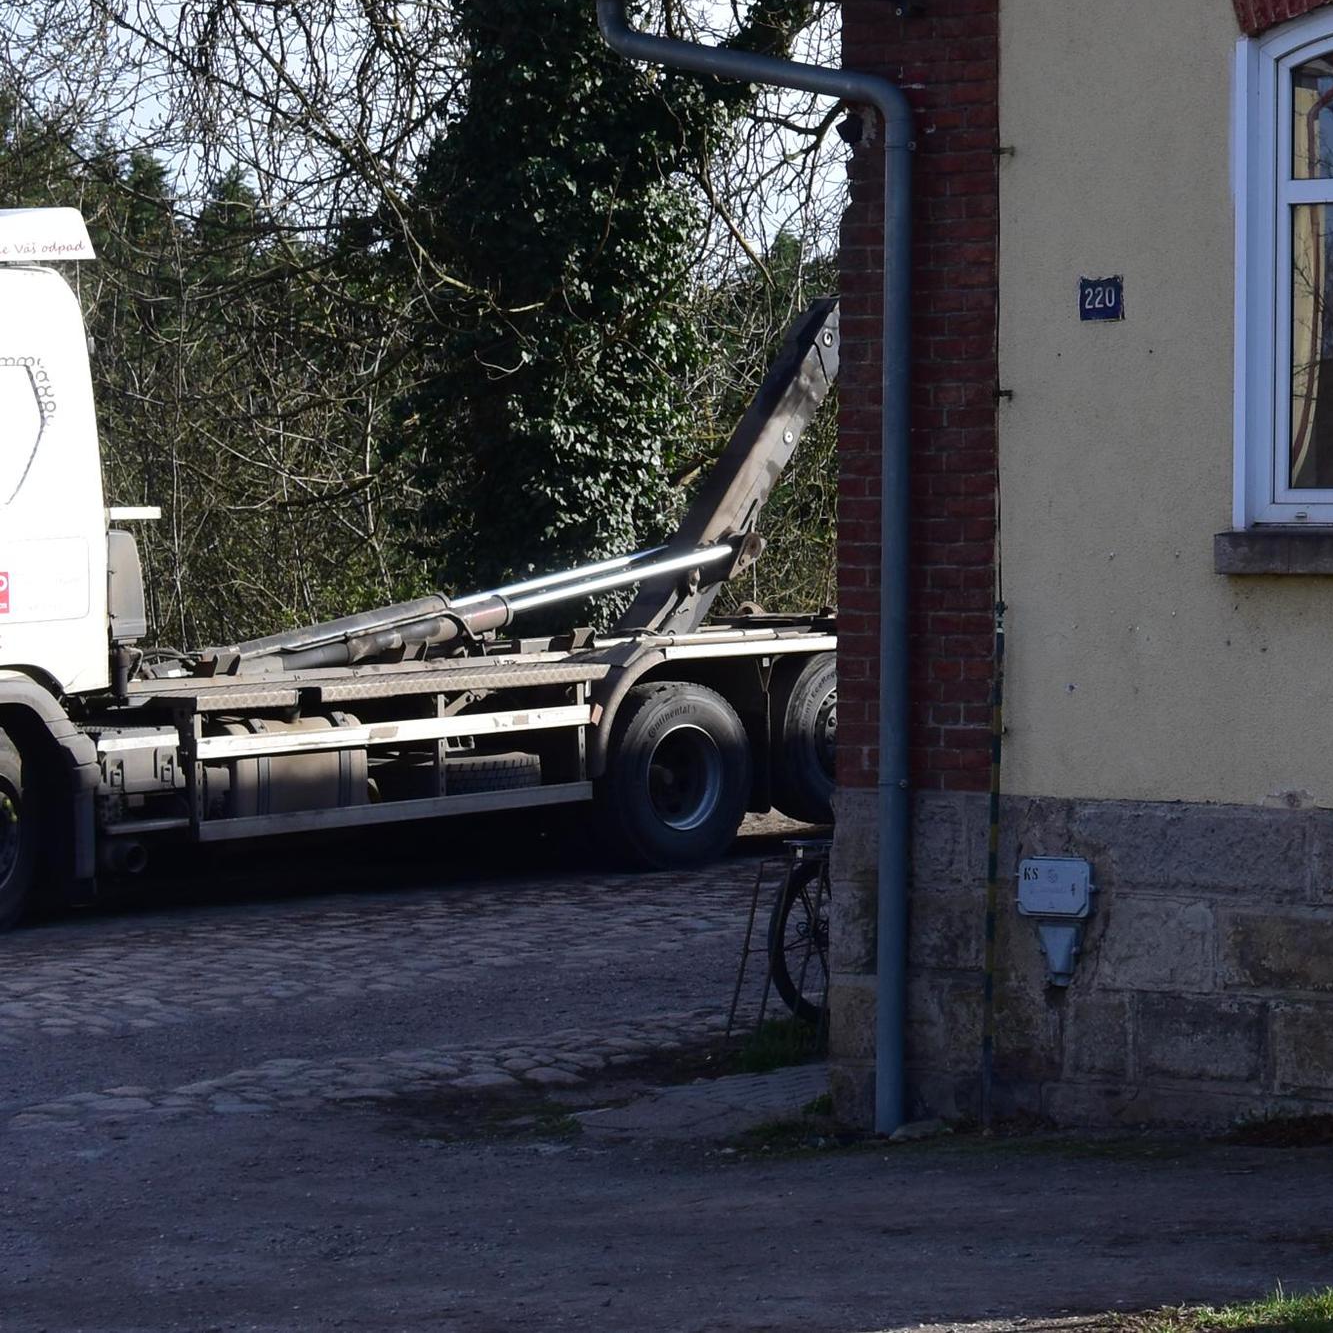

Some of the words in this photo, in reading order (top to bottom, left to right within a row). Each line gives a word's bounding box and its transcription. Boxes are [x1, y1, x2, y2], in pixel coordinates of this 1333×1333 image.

[1085, 287, 1115, 309] 220
[648, 704, 690, 738] Continental
[1024, 867, 1038, 880] KS
